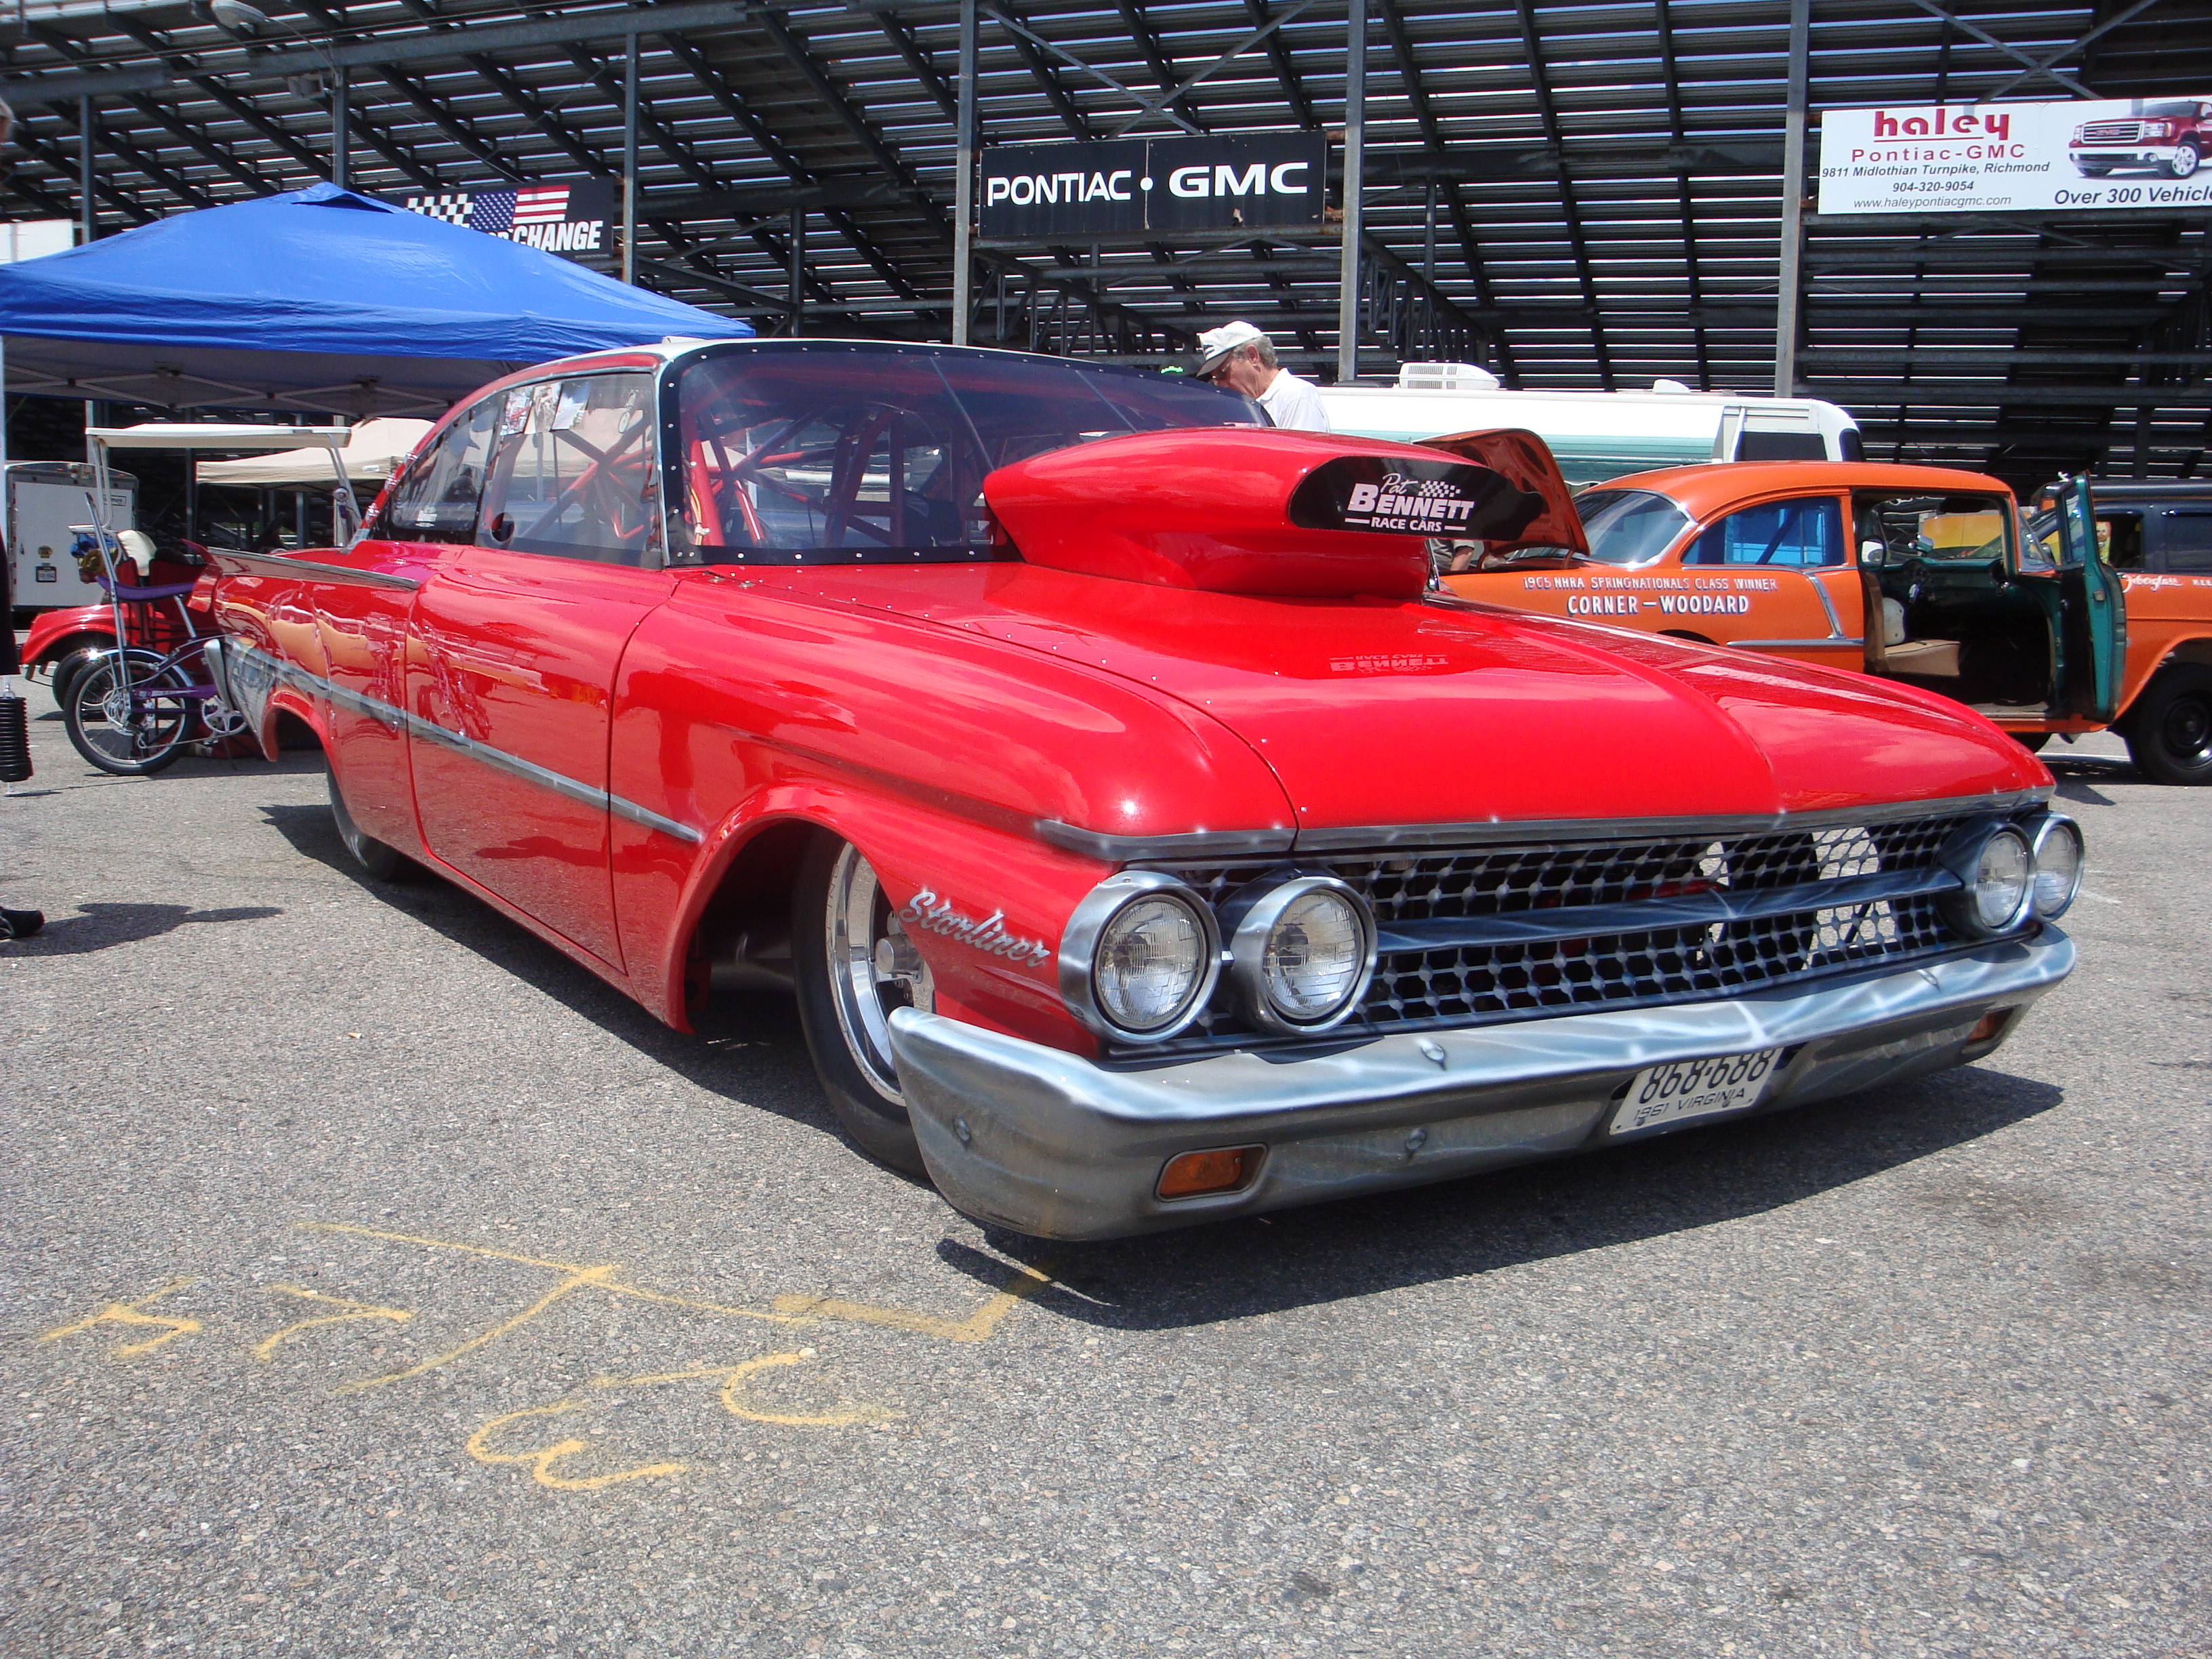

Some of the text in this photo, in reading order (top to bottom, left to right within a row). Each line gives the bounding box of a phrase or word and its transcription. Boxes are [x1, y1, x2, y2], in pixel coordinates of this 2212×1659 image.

[1874, 108, 2010, 141] haley
[1851, 144, 2026, 163] Pontiac-GMC
[1821, 161, 2051, 178] 9811 Midlothian Turnpike, Richmond
[987, 162, 1309, 207] PONTIAC GMC
[1892, 181, 1975, 192] 904-320-9054
[1853, 195, 2012, 209] www.haleypontiacgmc.com
[2054, 186, 2212, 205] Over 300 Vehicl
[513, 220, 604, 251] CHANGE
[1380, 472, 1418, 495] Pat
[1347, 483, 1475, 520] BENNETT
[1370, 516, 1442, 532] RACE CARS
[1553, 577, 1585, 590] NHRA
[1590, 577, 1689, 590] SPRINGNATIONALS
[1694, 577, 1729, 590] CLASS
[1734, 578, 1778, 591] WINNER
[1567, 595, 1639, 615] CORNER
[1659, 595, 1749, 614] WOODARD
[899, 890, 1051, 967] Starliner
[1633, 1087, 1746, 1121] 1961 VIRGINIA
